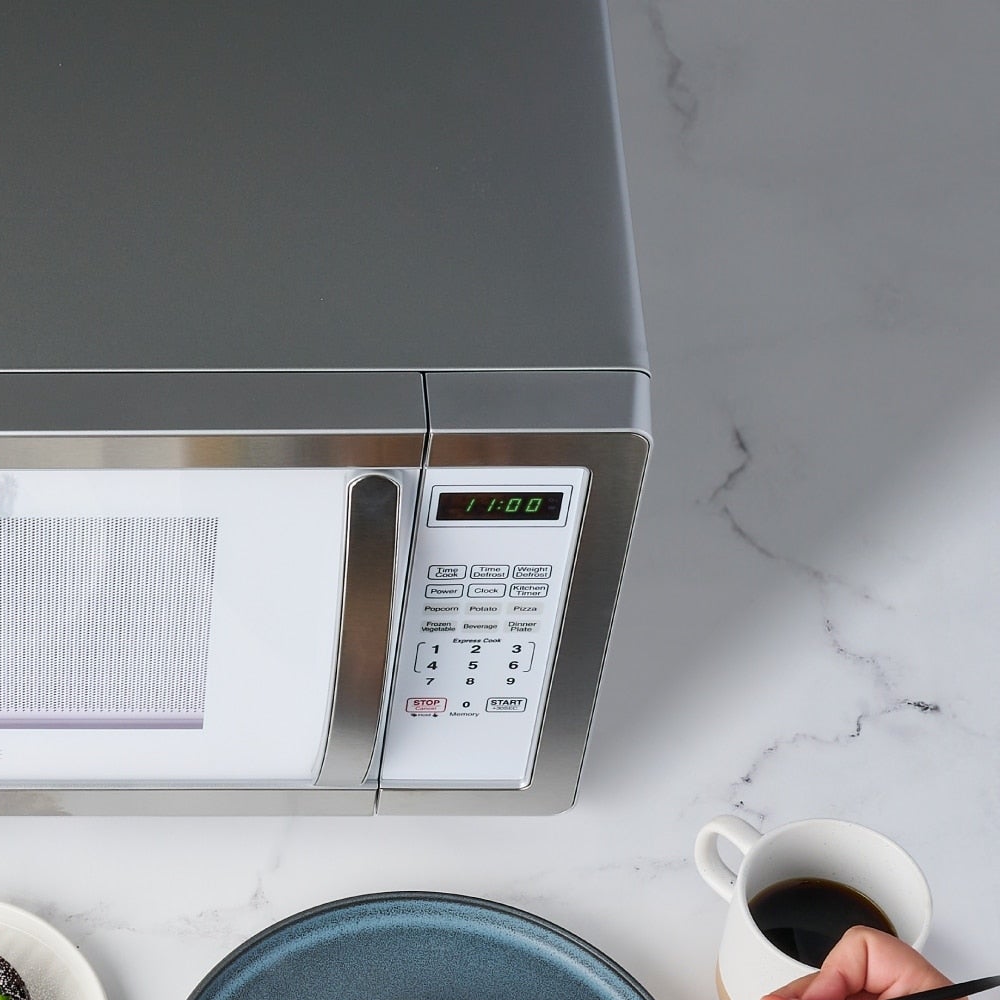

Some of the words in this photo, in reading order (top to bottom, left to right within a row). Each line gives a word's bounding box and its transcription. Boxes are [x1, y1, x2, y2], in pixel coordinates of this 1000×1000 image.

[466, 498, 543, 512] 11:00
[432, 645, 440, 654] 1
[470, 645, 481, 654] 2
[511, 645, 522, 654] 3
[427, 661, 438, 670] 4
[468, 661, 479, 670] 5
[508, 661, 519, 670] 6
[425, 677, 435, 685] 7
[465, 677, 475, 685] 8
[506, 677, 516, 685] 9
